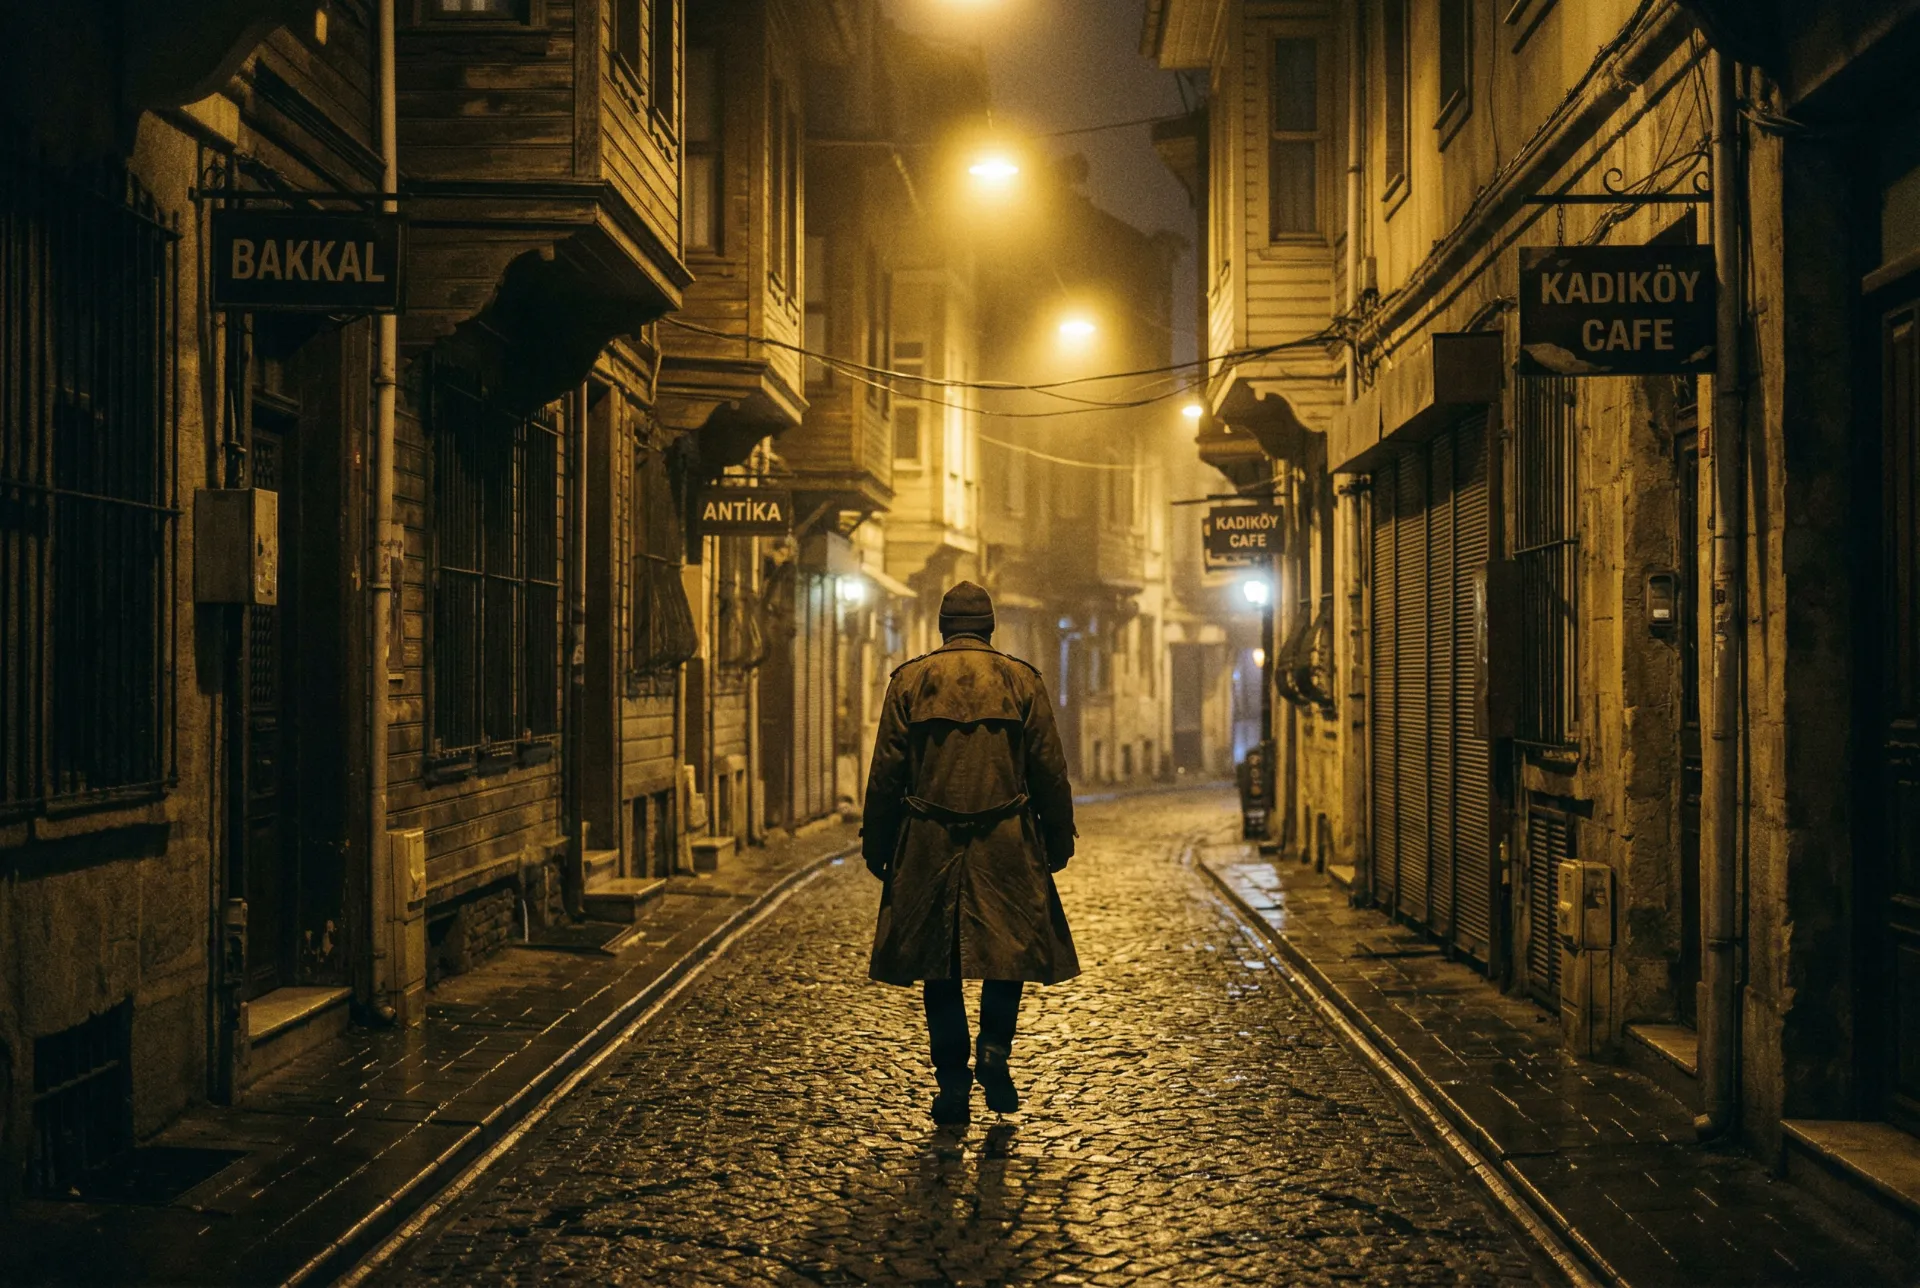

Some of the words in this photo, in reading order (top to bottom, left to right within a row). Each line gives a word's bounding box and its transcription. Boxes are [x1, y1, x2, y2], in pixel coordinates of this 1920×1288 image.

[231, 238, 385, 283] BAKKAL
[1541, 263, 1700, 304] KADIKÖY
[1582, 318, 1675, 351] CAFE
[703, 497, 782, 521] ANTİKA
[1215, 512, 1279, 530] KADIKÖY
[1229, 533, 1267, 548] CAFE
